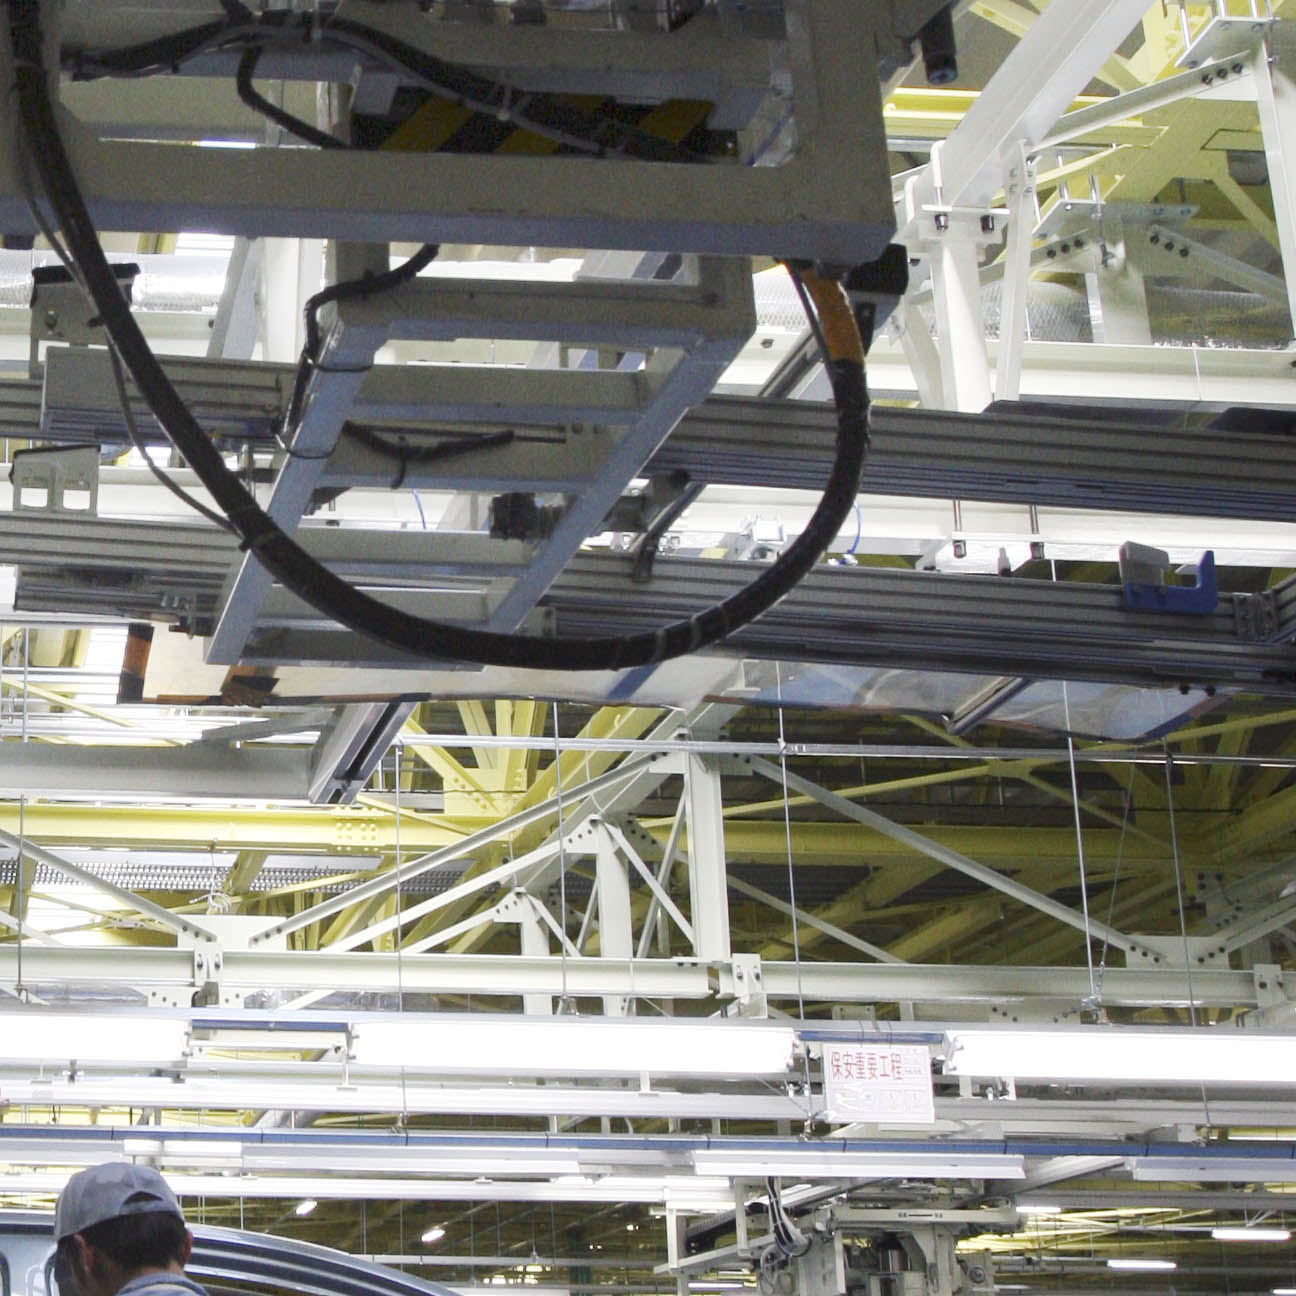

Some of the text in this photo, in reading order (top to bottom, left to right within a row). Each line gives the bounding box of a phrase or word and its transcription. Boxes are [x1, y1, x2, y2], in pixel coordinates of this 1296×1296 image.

[831, 1051, 903, 1080] 保安重要工程
